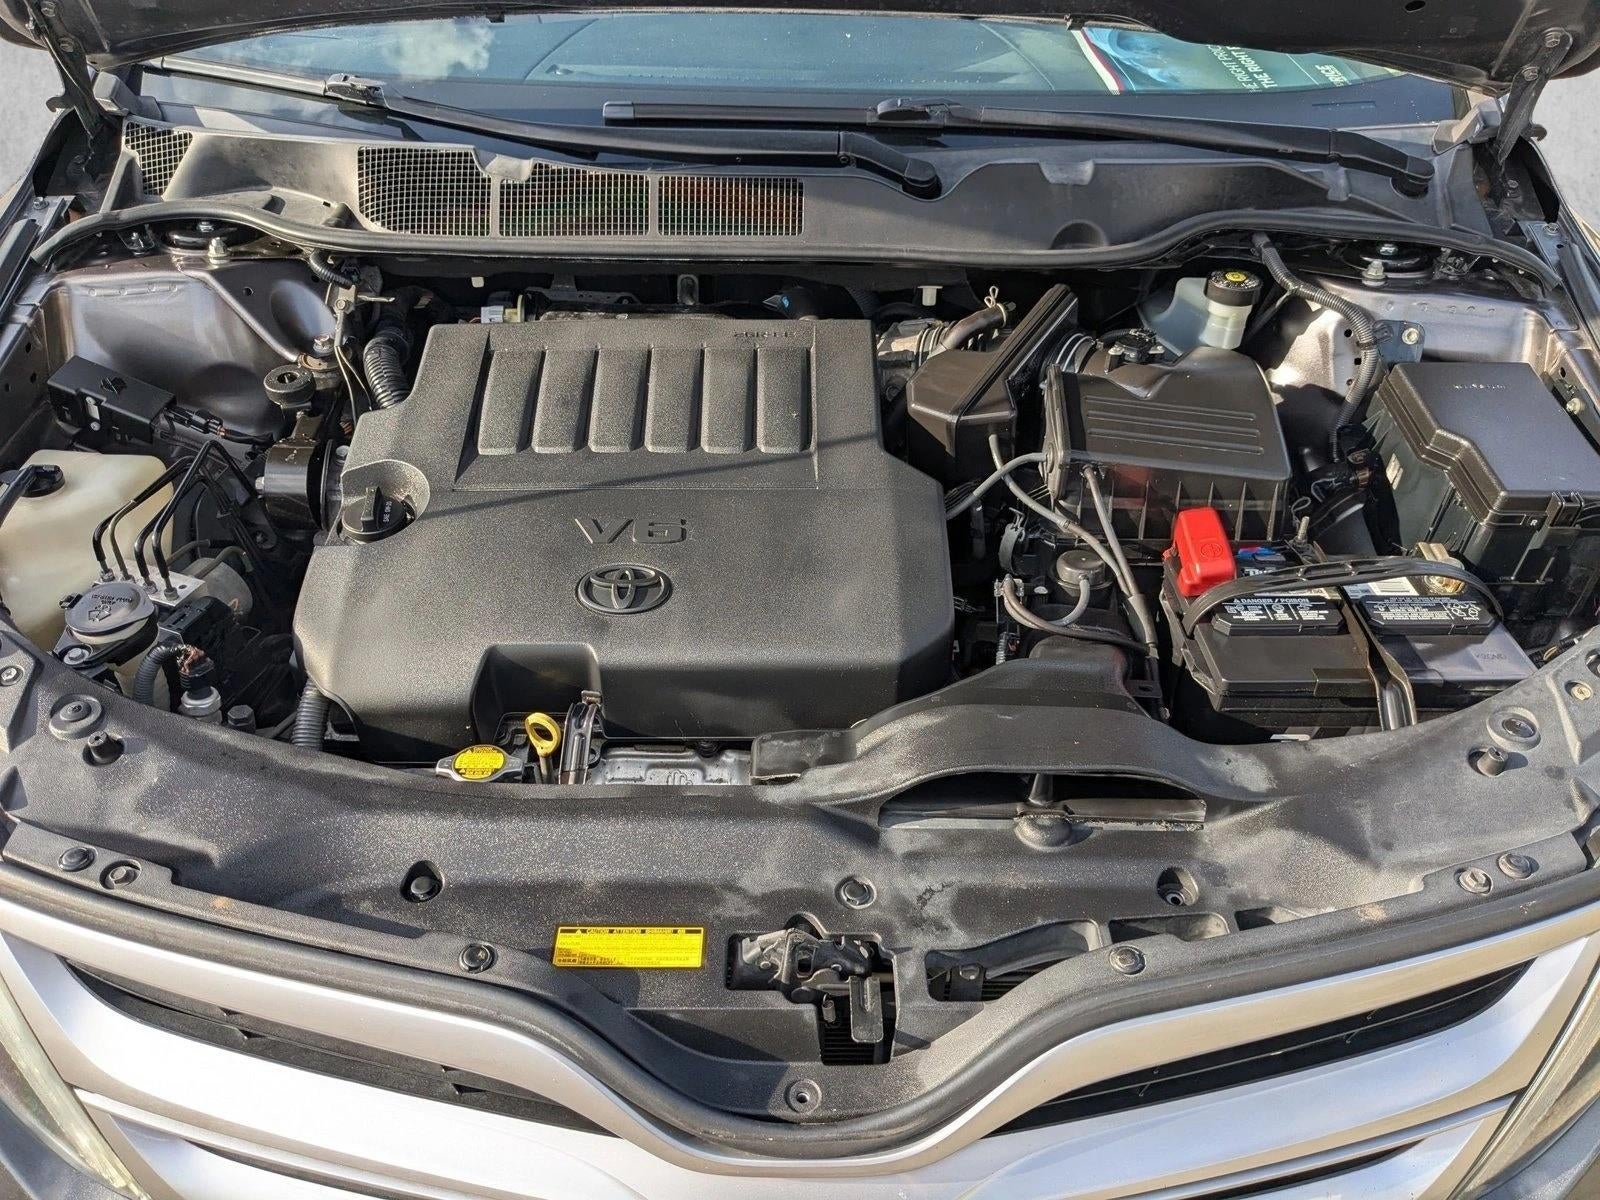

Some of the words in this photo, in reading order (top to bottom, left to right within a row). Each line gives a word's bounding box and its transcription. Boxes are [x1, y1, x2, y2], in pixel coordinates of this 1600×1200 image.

[1207, 45, 1233, 62] PRIC
[1230, 50, 1264, 73] RIGHT
[1222, 60, 1252, 82] RIGHT
[1253, 72, 1279, 89] THE
[574, 517, 687, 545] V6
